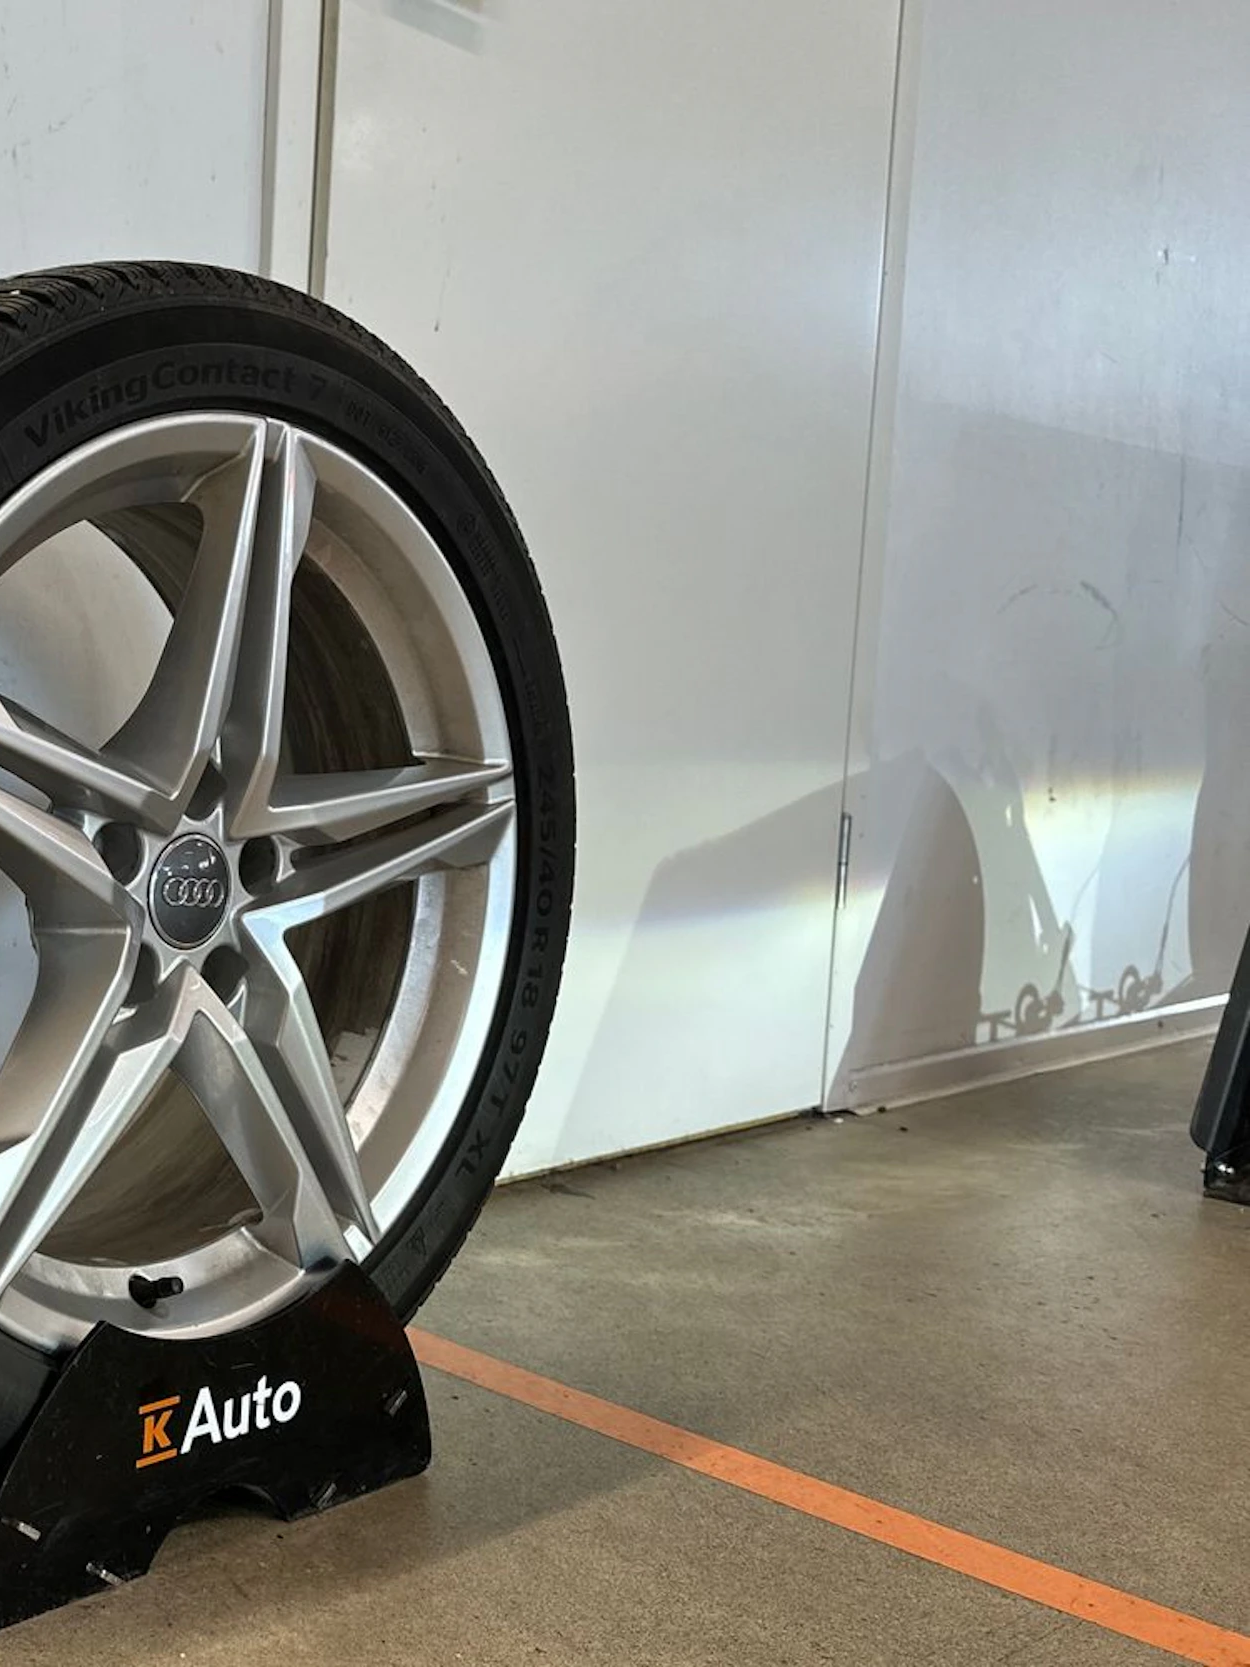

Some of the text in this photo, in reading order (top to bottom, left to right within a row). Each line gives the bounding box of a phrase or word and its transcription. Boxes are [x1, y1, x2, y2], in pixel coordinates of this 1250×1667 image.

[24, 360, 295, 449] VikingContact
[307, 376, 327, 401] 7
[455, 1129, 491, 1178] XL
[180, 1374, 303, 1455] Auto
